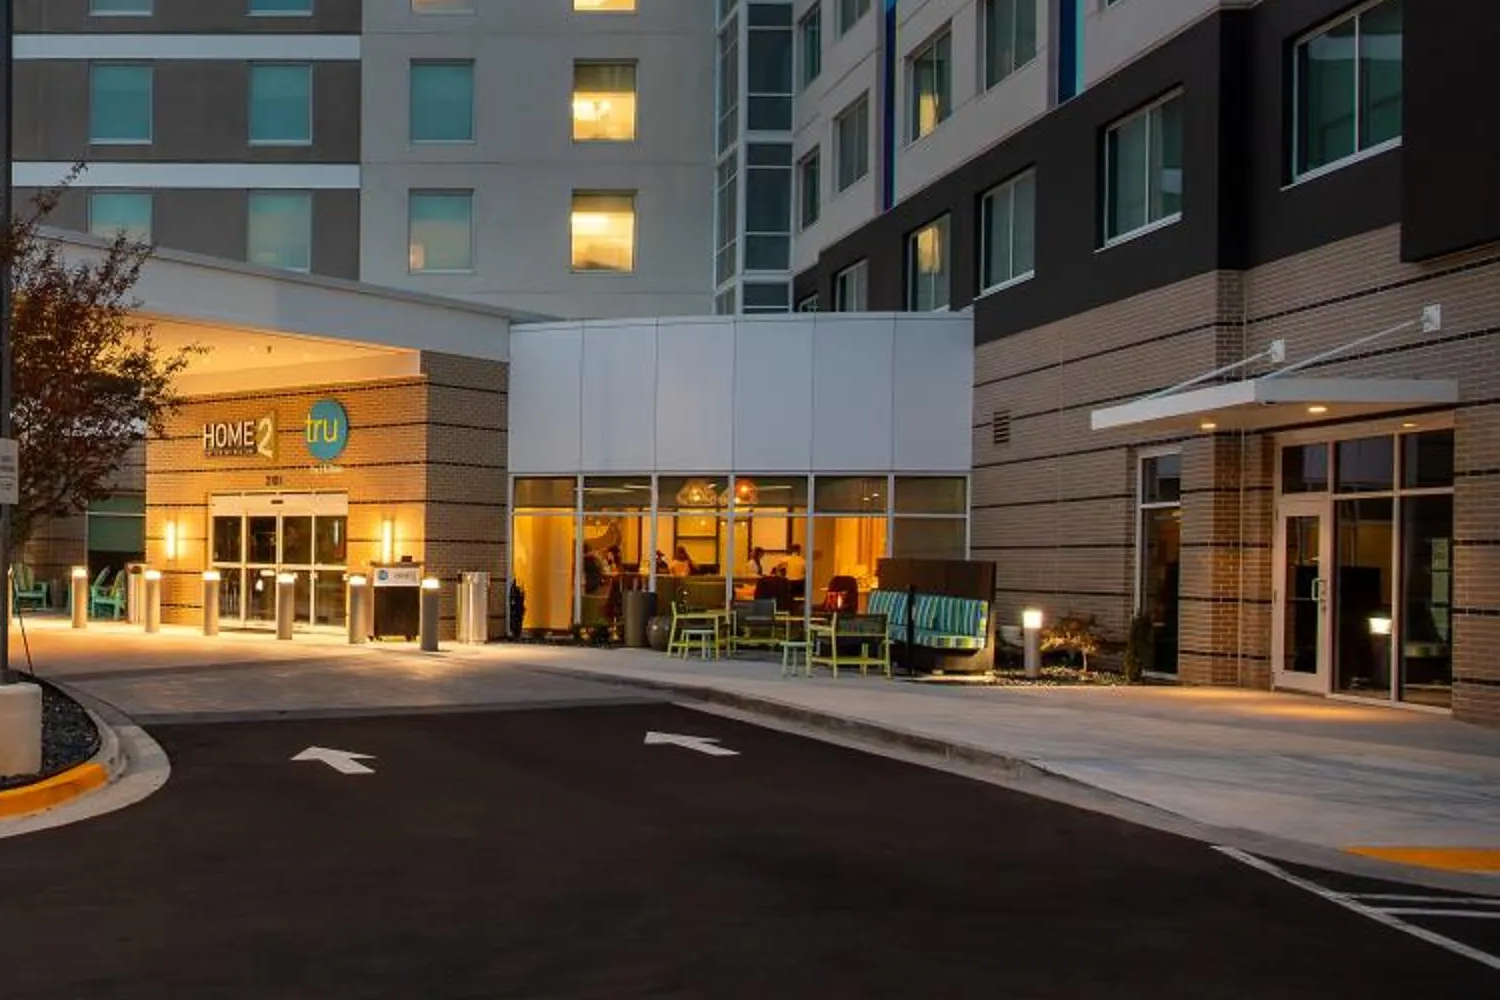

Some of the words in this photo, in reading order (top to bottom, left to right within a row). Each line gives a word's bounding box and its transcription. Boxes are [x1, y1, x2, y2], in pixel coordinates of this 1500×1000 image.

[203, 421, 255, 449] HOME
[257, 417, 274, 459] 2
[305, 413, 337, 444] tru
